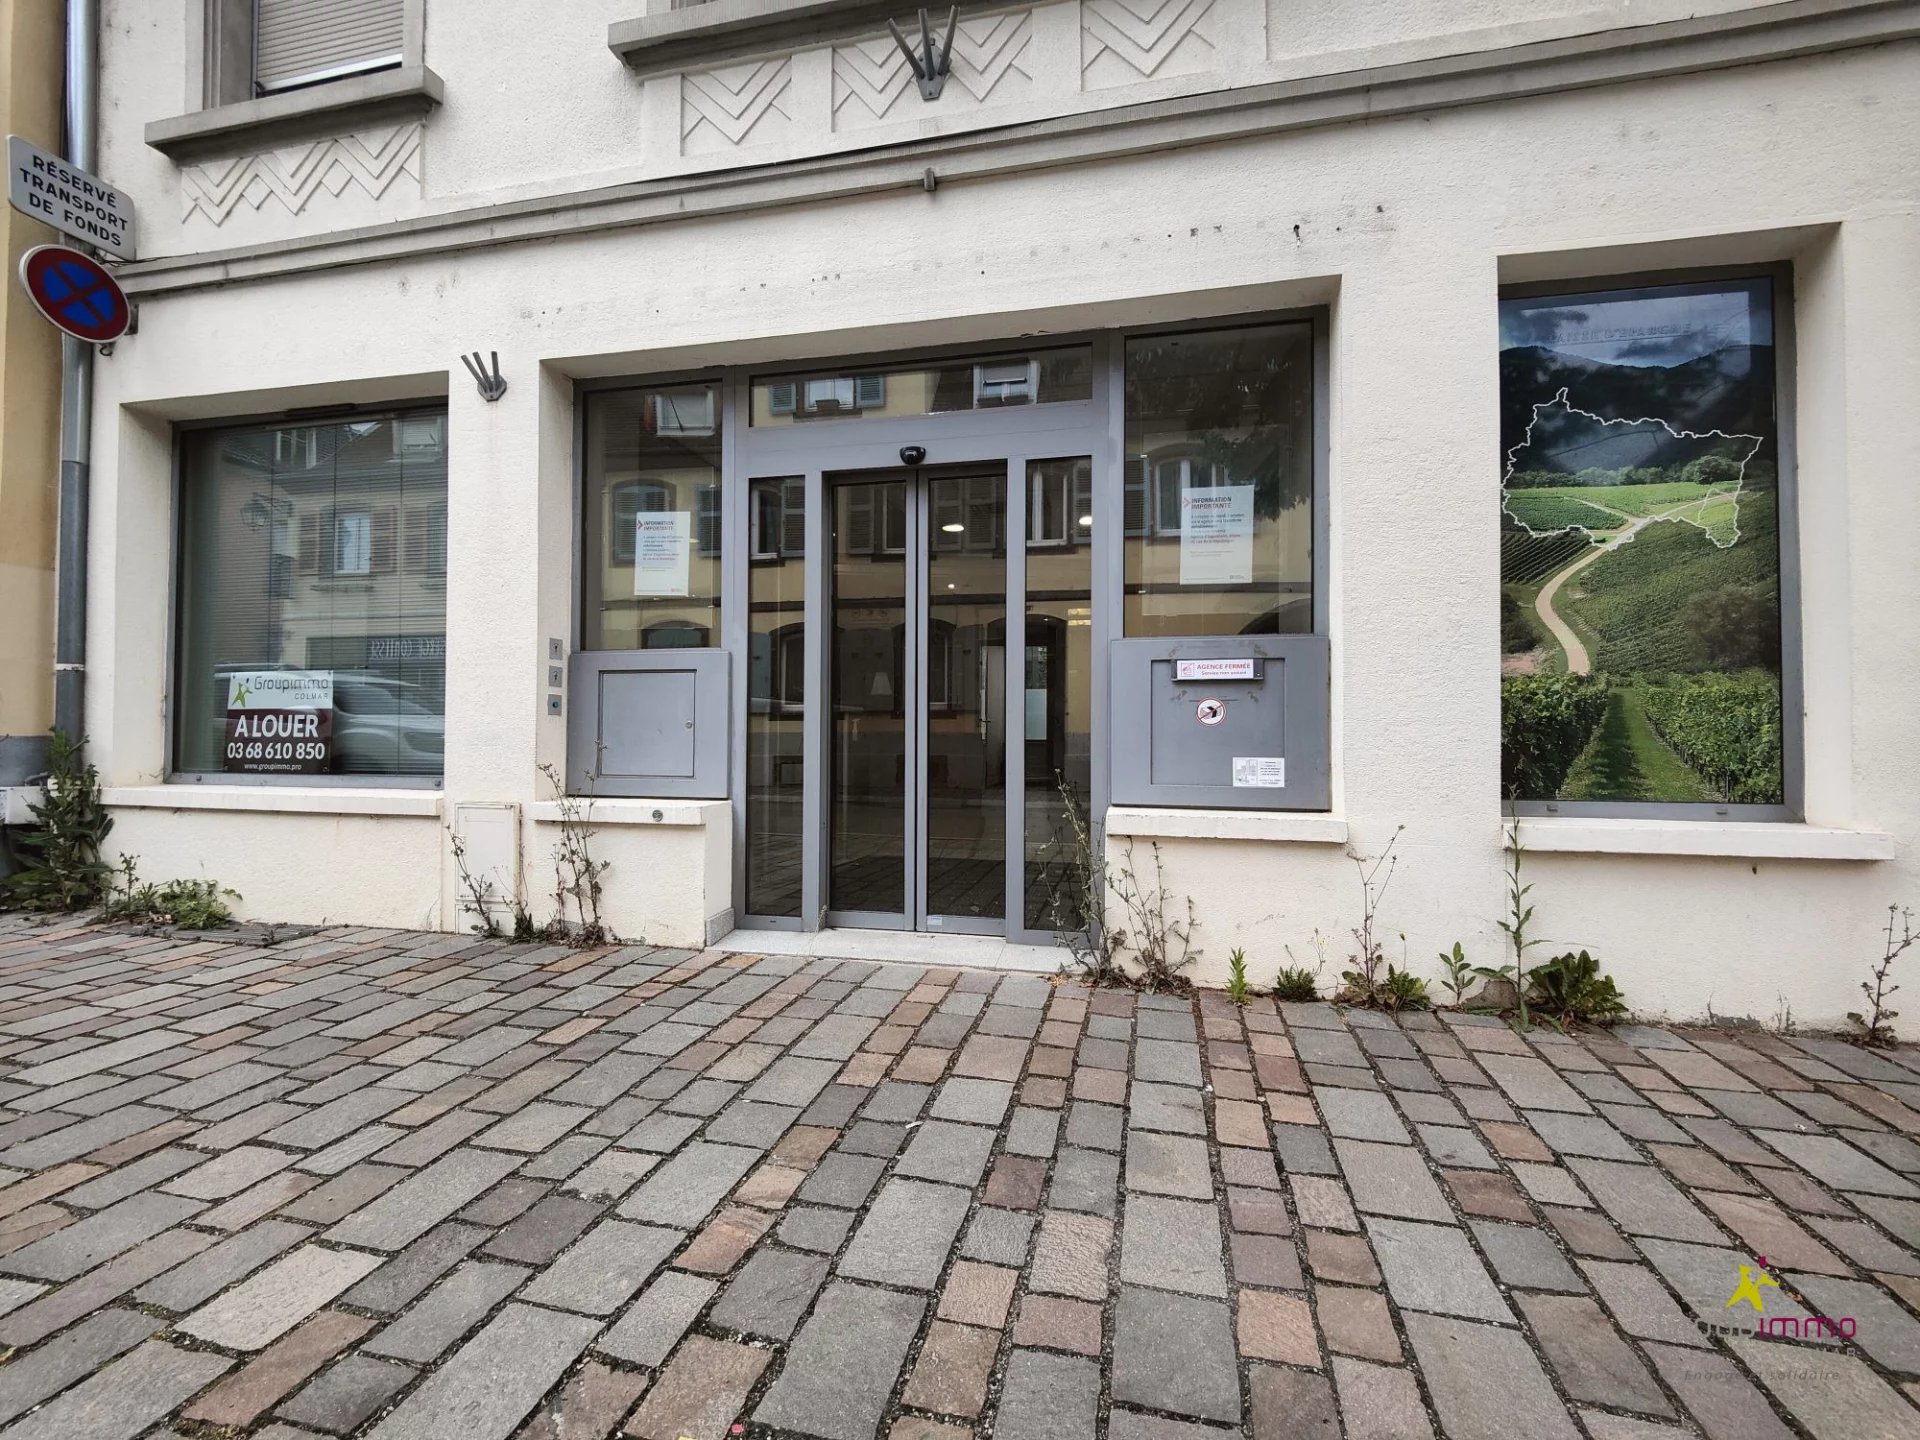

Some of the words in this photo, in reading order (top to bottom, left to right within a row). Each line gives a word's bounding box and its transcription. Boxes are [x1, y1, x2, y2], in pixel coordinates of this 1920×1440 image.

[32, 154, 117, 208] RÉSERVÉ
[19, 168, 128, 231] TRANSPORT
[29, 192, 54, 215] DE
[64, 209, 122, 247] FONDS
[254, 676, 329, 693] Groupimmo
[294, 692, 329, 700] COLMAR
[234, 715, 248, 738] A
[252, 714, 319, 738] LOUER
[227, 742, 244, 758] 03
[245, 742, 262, 758] 68
[265, 742, 292, 759] 610
[296, 742, 325, 759] 850
